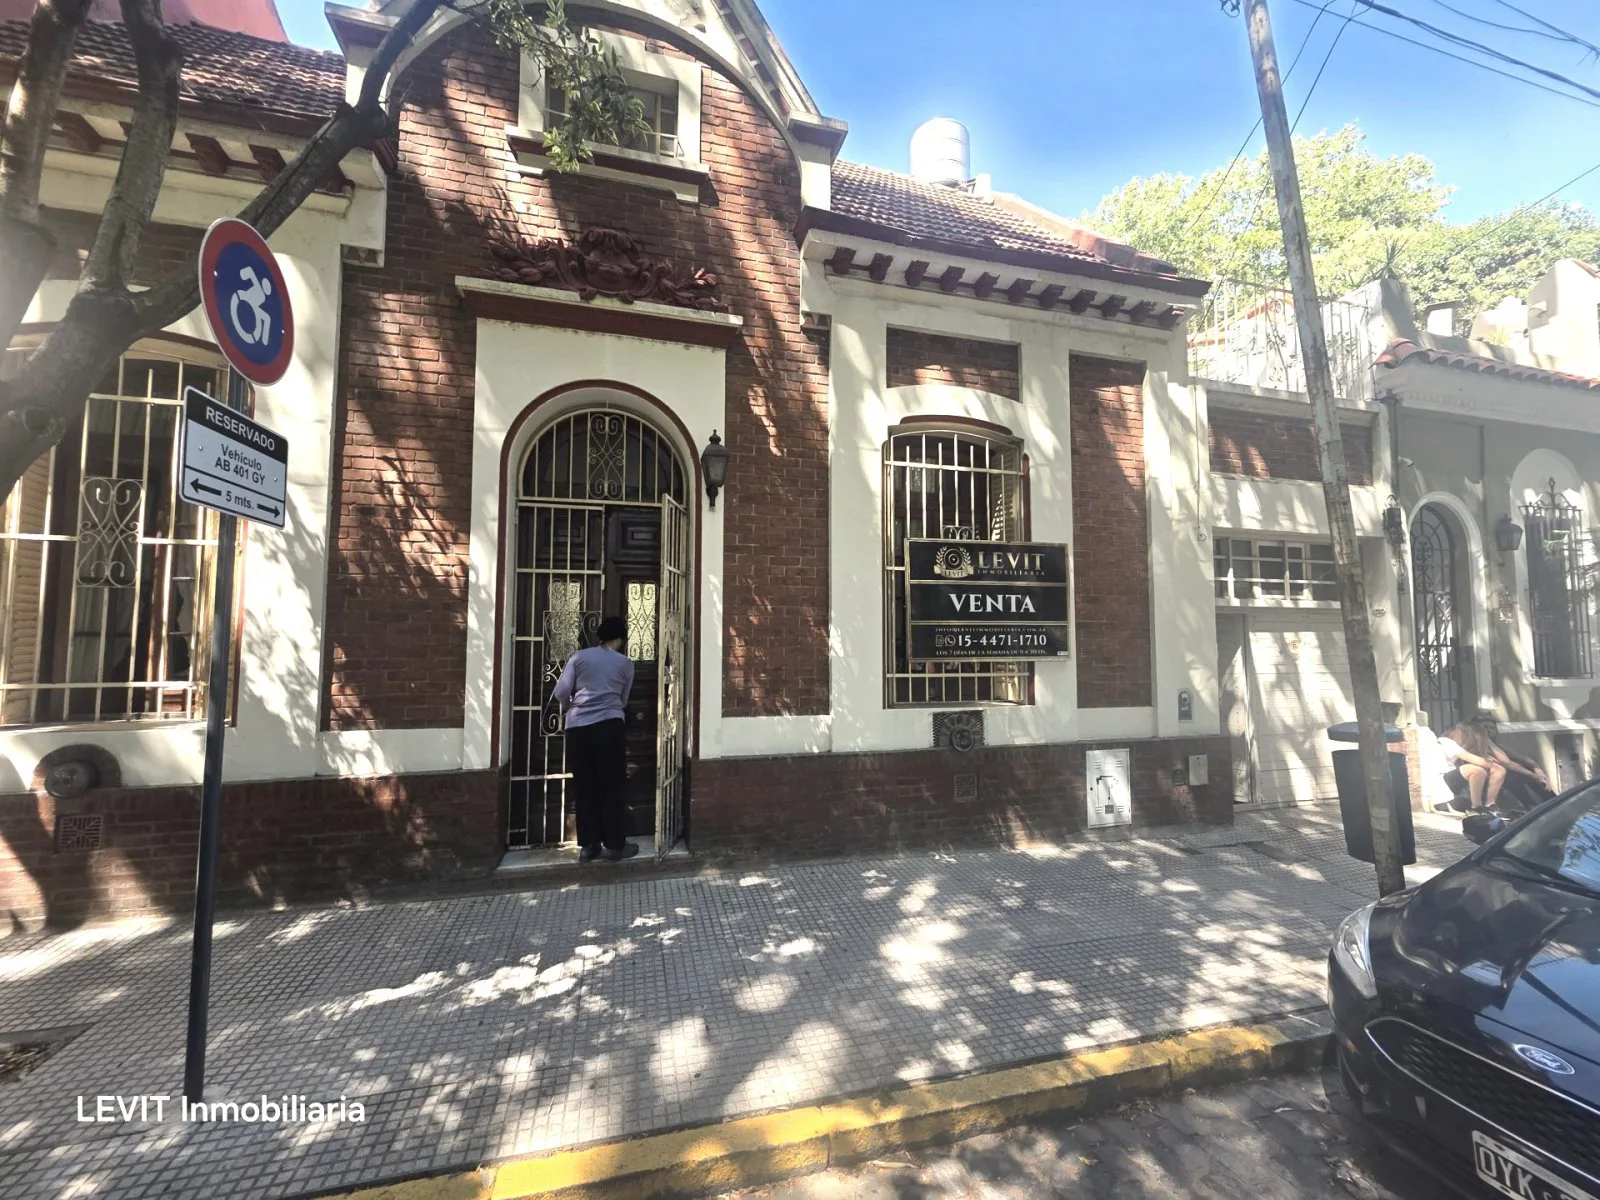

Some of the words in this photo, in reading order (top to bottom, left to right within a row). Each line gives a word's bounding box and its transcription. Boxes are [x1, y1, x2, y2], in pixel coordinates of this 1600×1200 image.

[205, 406, 275, 451] RESERVADO
[214, 457, 231, 472] AB
[233, 464, 249, 480] 401
[251, 471, 266, 486] GY
[225, 491, 232, 502] 5
[234, 496, 254, 510] mts.
[978, 551, 1045, 571] LEVIT
[949, 593, 1036, 613] VENTA
[958, 634, 1048, 647] 15-4471-1710
